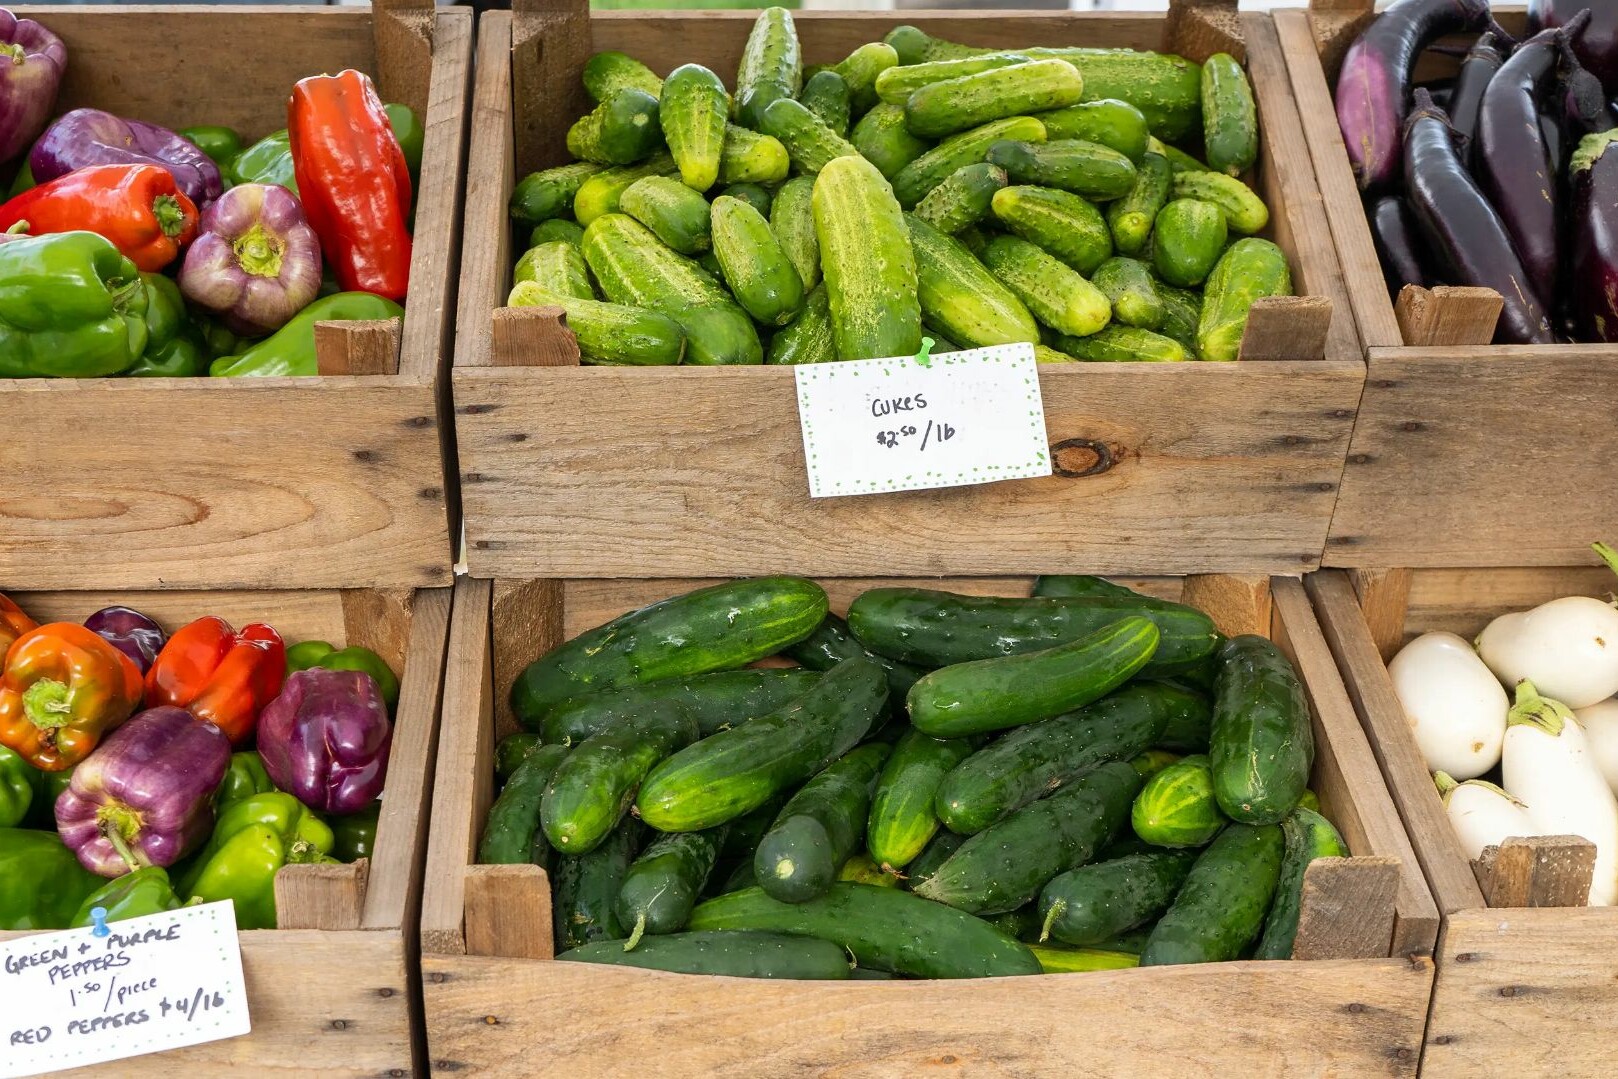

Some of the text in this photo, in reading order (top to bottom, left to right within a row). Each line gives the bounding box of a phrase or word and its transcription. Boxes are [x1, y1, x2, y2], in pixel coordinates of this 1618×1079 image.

[4, 945, 68, 974] GREEN
[106, 923, 181, 950] PURPLE
[48, 950, 131, 985] PEPPERS
[9, 1025, 52, 1046] RED
[67, 1008, 150, 1035] PEPPERS
